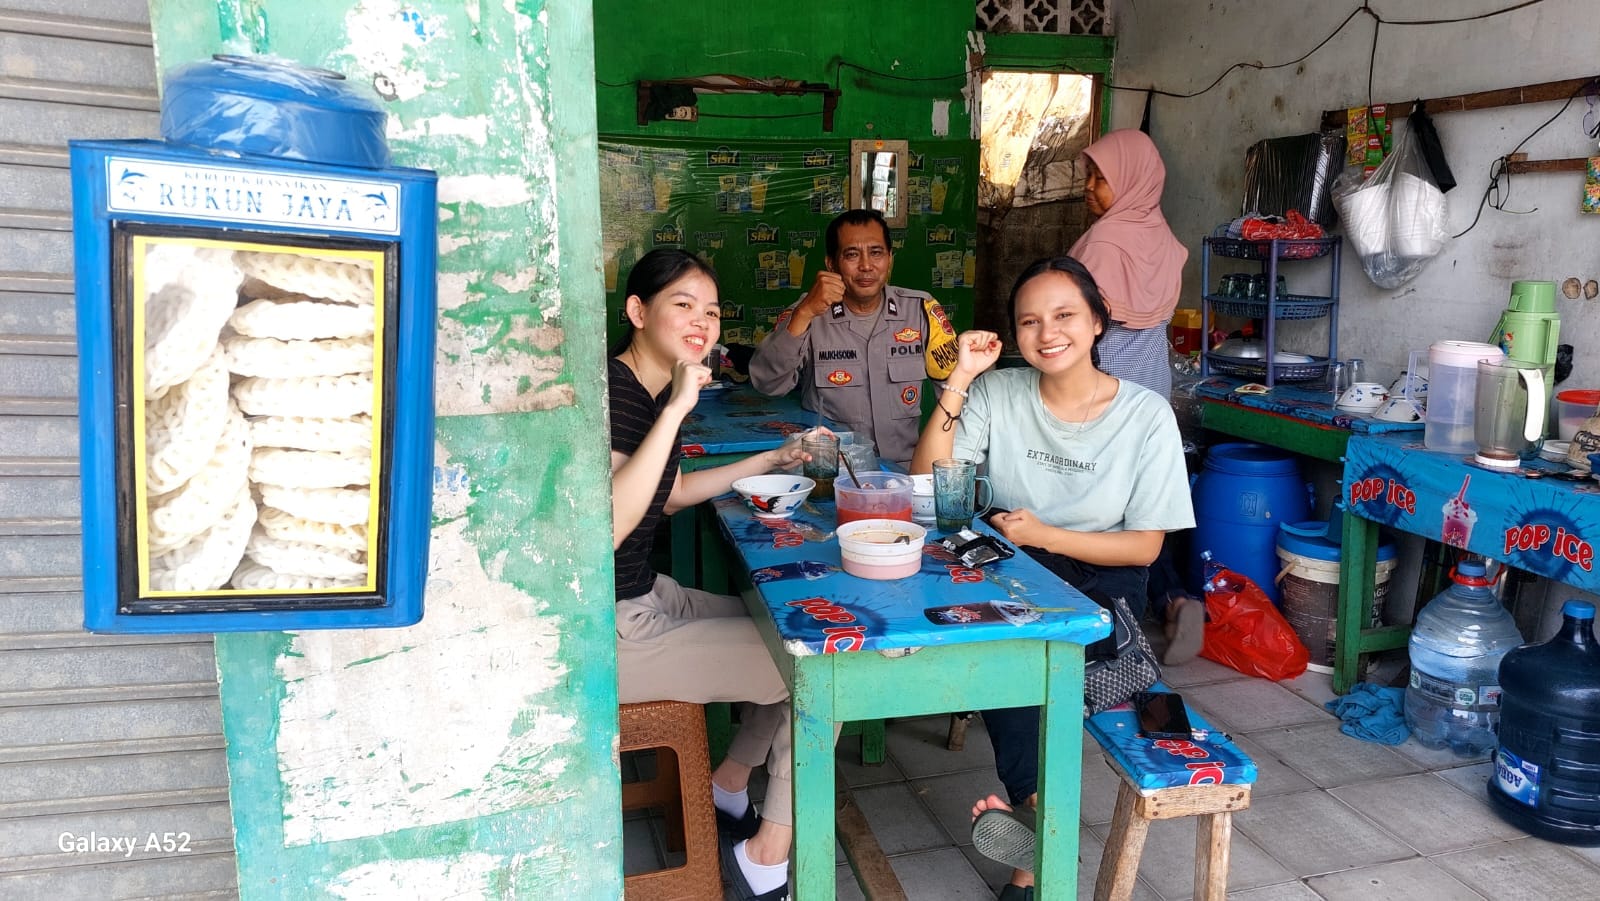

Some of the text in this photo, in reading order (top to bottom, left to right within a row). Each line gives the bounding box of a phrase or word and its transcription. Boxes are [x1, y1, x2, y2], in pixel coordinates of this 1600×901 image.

[160, 183, 352, 221] RUKUN JAYA
[1026, 449, 1097, 471] EXTRAORDINARY
